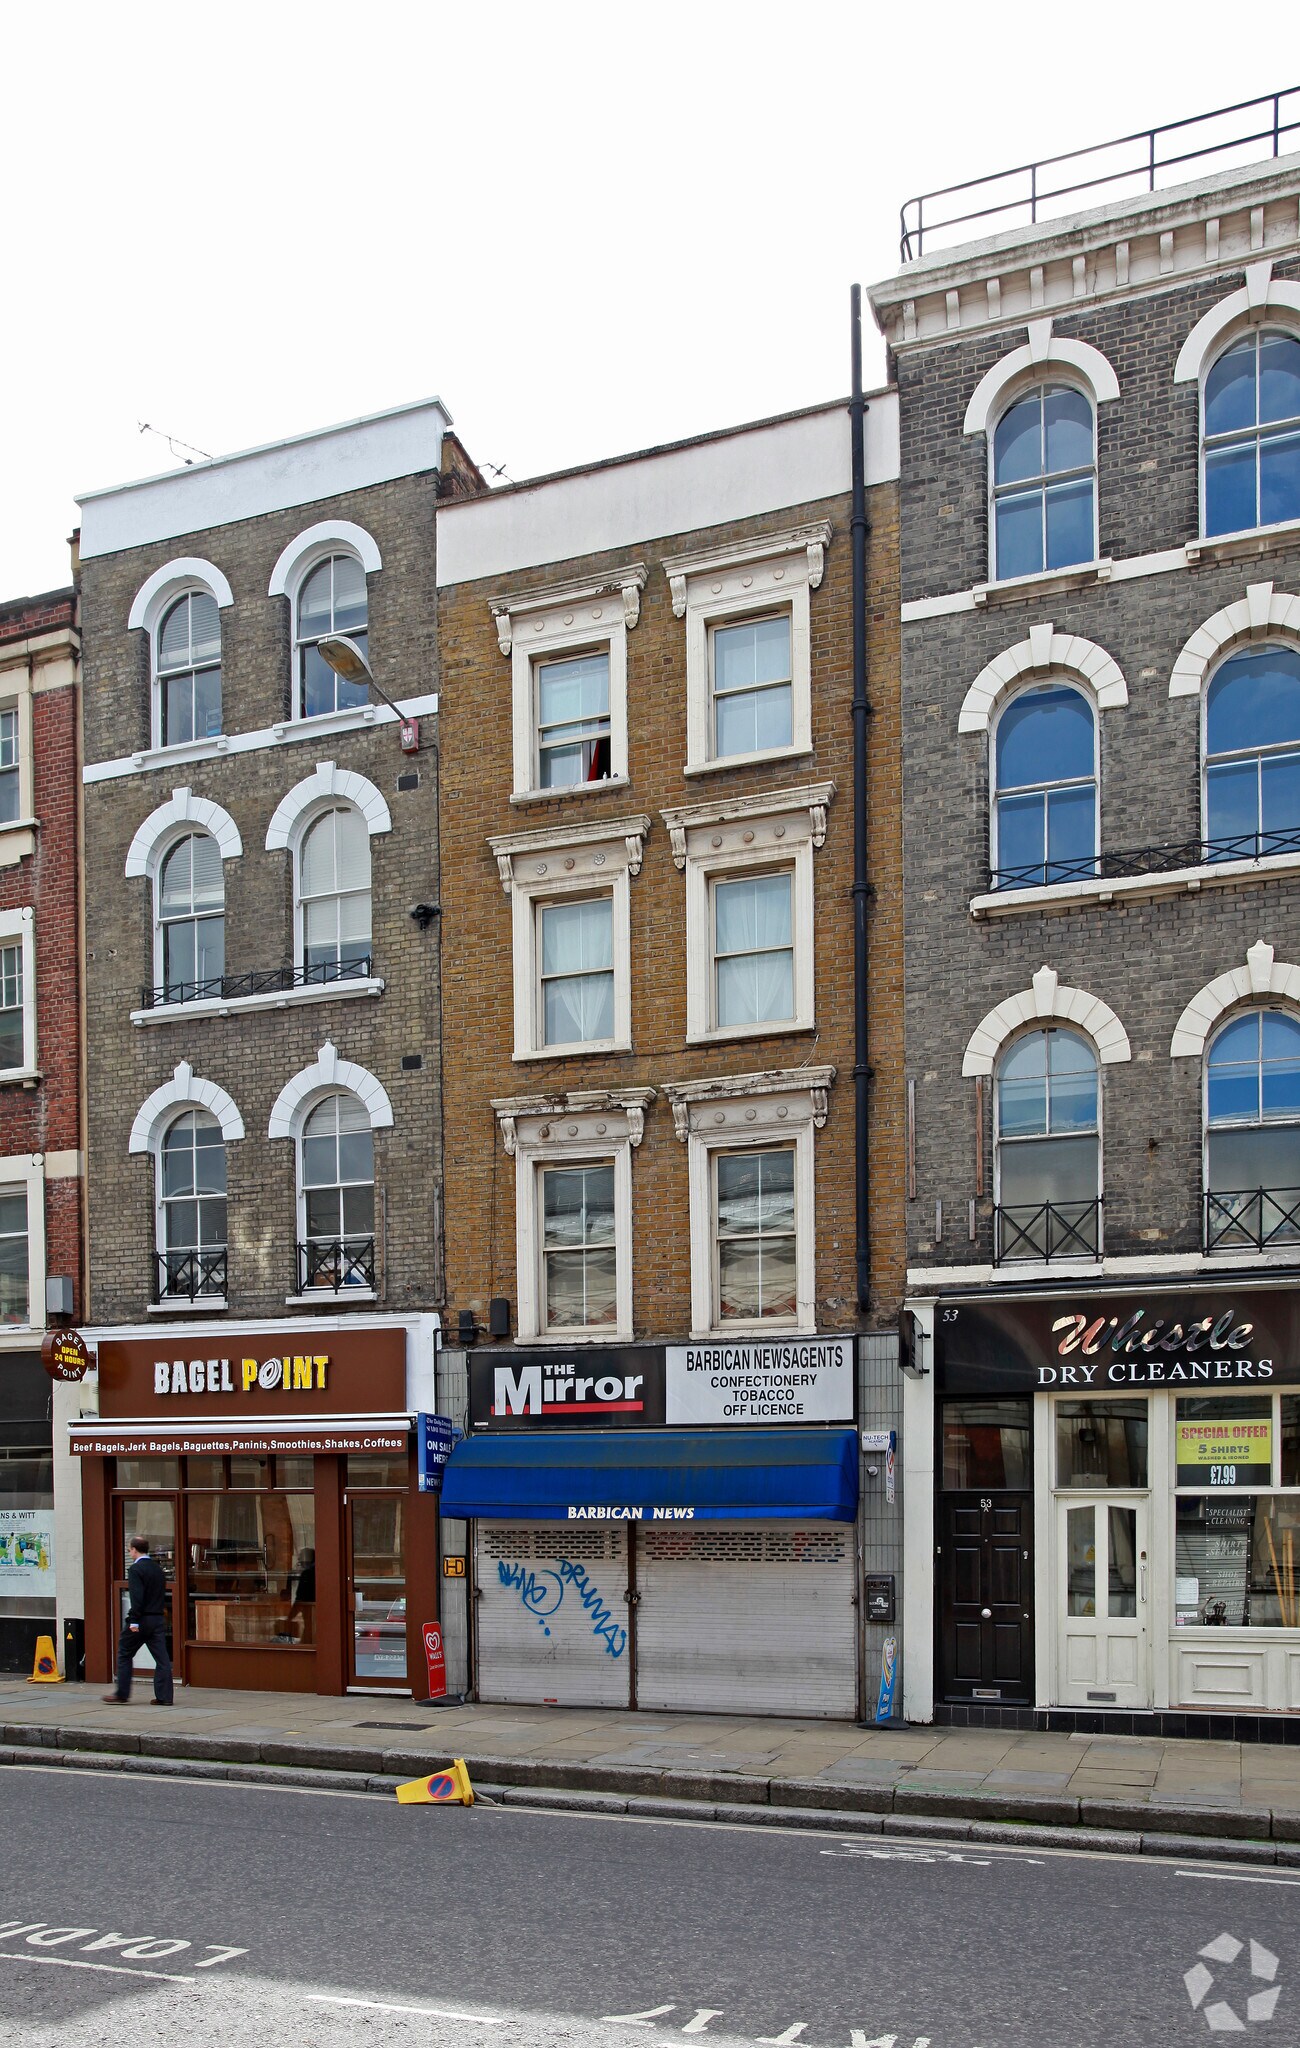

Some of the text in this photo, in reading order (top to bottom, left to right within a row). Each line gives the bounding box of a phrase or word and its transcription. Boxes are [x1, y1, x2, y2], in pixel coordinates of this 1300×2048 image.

[942, 1310, 958, 1322] 53
[1052, 1309, 1254, 1355] Whistle
[55, 1332, 82, 1351] BAGEL
[61, 1346, 79, 1356] OPEN
[54, 1353, 86, 1366] 24 HOURS
[686, 1345, 844, 1372] BARBICAN NEWSAGENTS
[57, 1363, 82, 1379] POINT
[153, 1355, 329, 1394] BAGEL POINT
[543, 1364, 576, 1376] THE
[1037, 1359, 1275, 1384] DRY CLEANERS
[710, 1374, 818, 1388] CONFECTIONERY
[494, 1365, 644, 1416] Mirror
[732, 1389, 795, 1402] TOBACCO
[723, 1403, 805, 1417] OFF LICENCE
[1181, 1425, 1268, 1439] SPECIAL OFFER
[73, 1442, 93, 1451] Beef
[427, 1440, 452, 1454] ON SALE
[1198, 1444, 1250, 1454] 5 SHIRTS
[1210, 1465, 1236, 1485] £7.99
[980, 1498, 992, 1508] 53
[567, 1506, 695, 1519] BARBICAN NEWS
[1208, 1508, 1248, 1517] SPECIALIST
[1211, 1517, 1246, 1525] CLEANING
[1214, 1540, 1242, 1548] SHIRT
